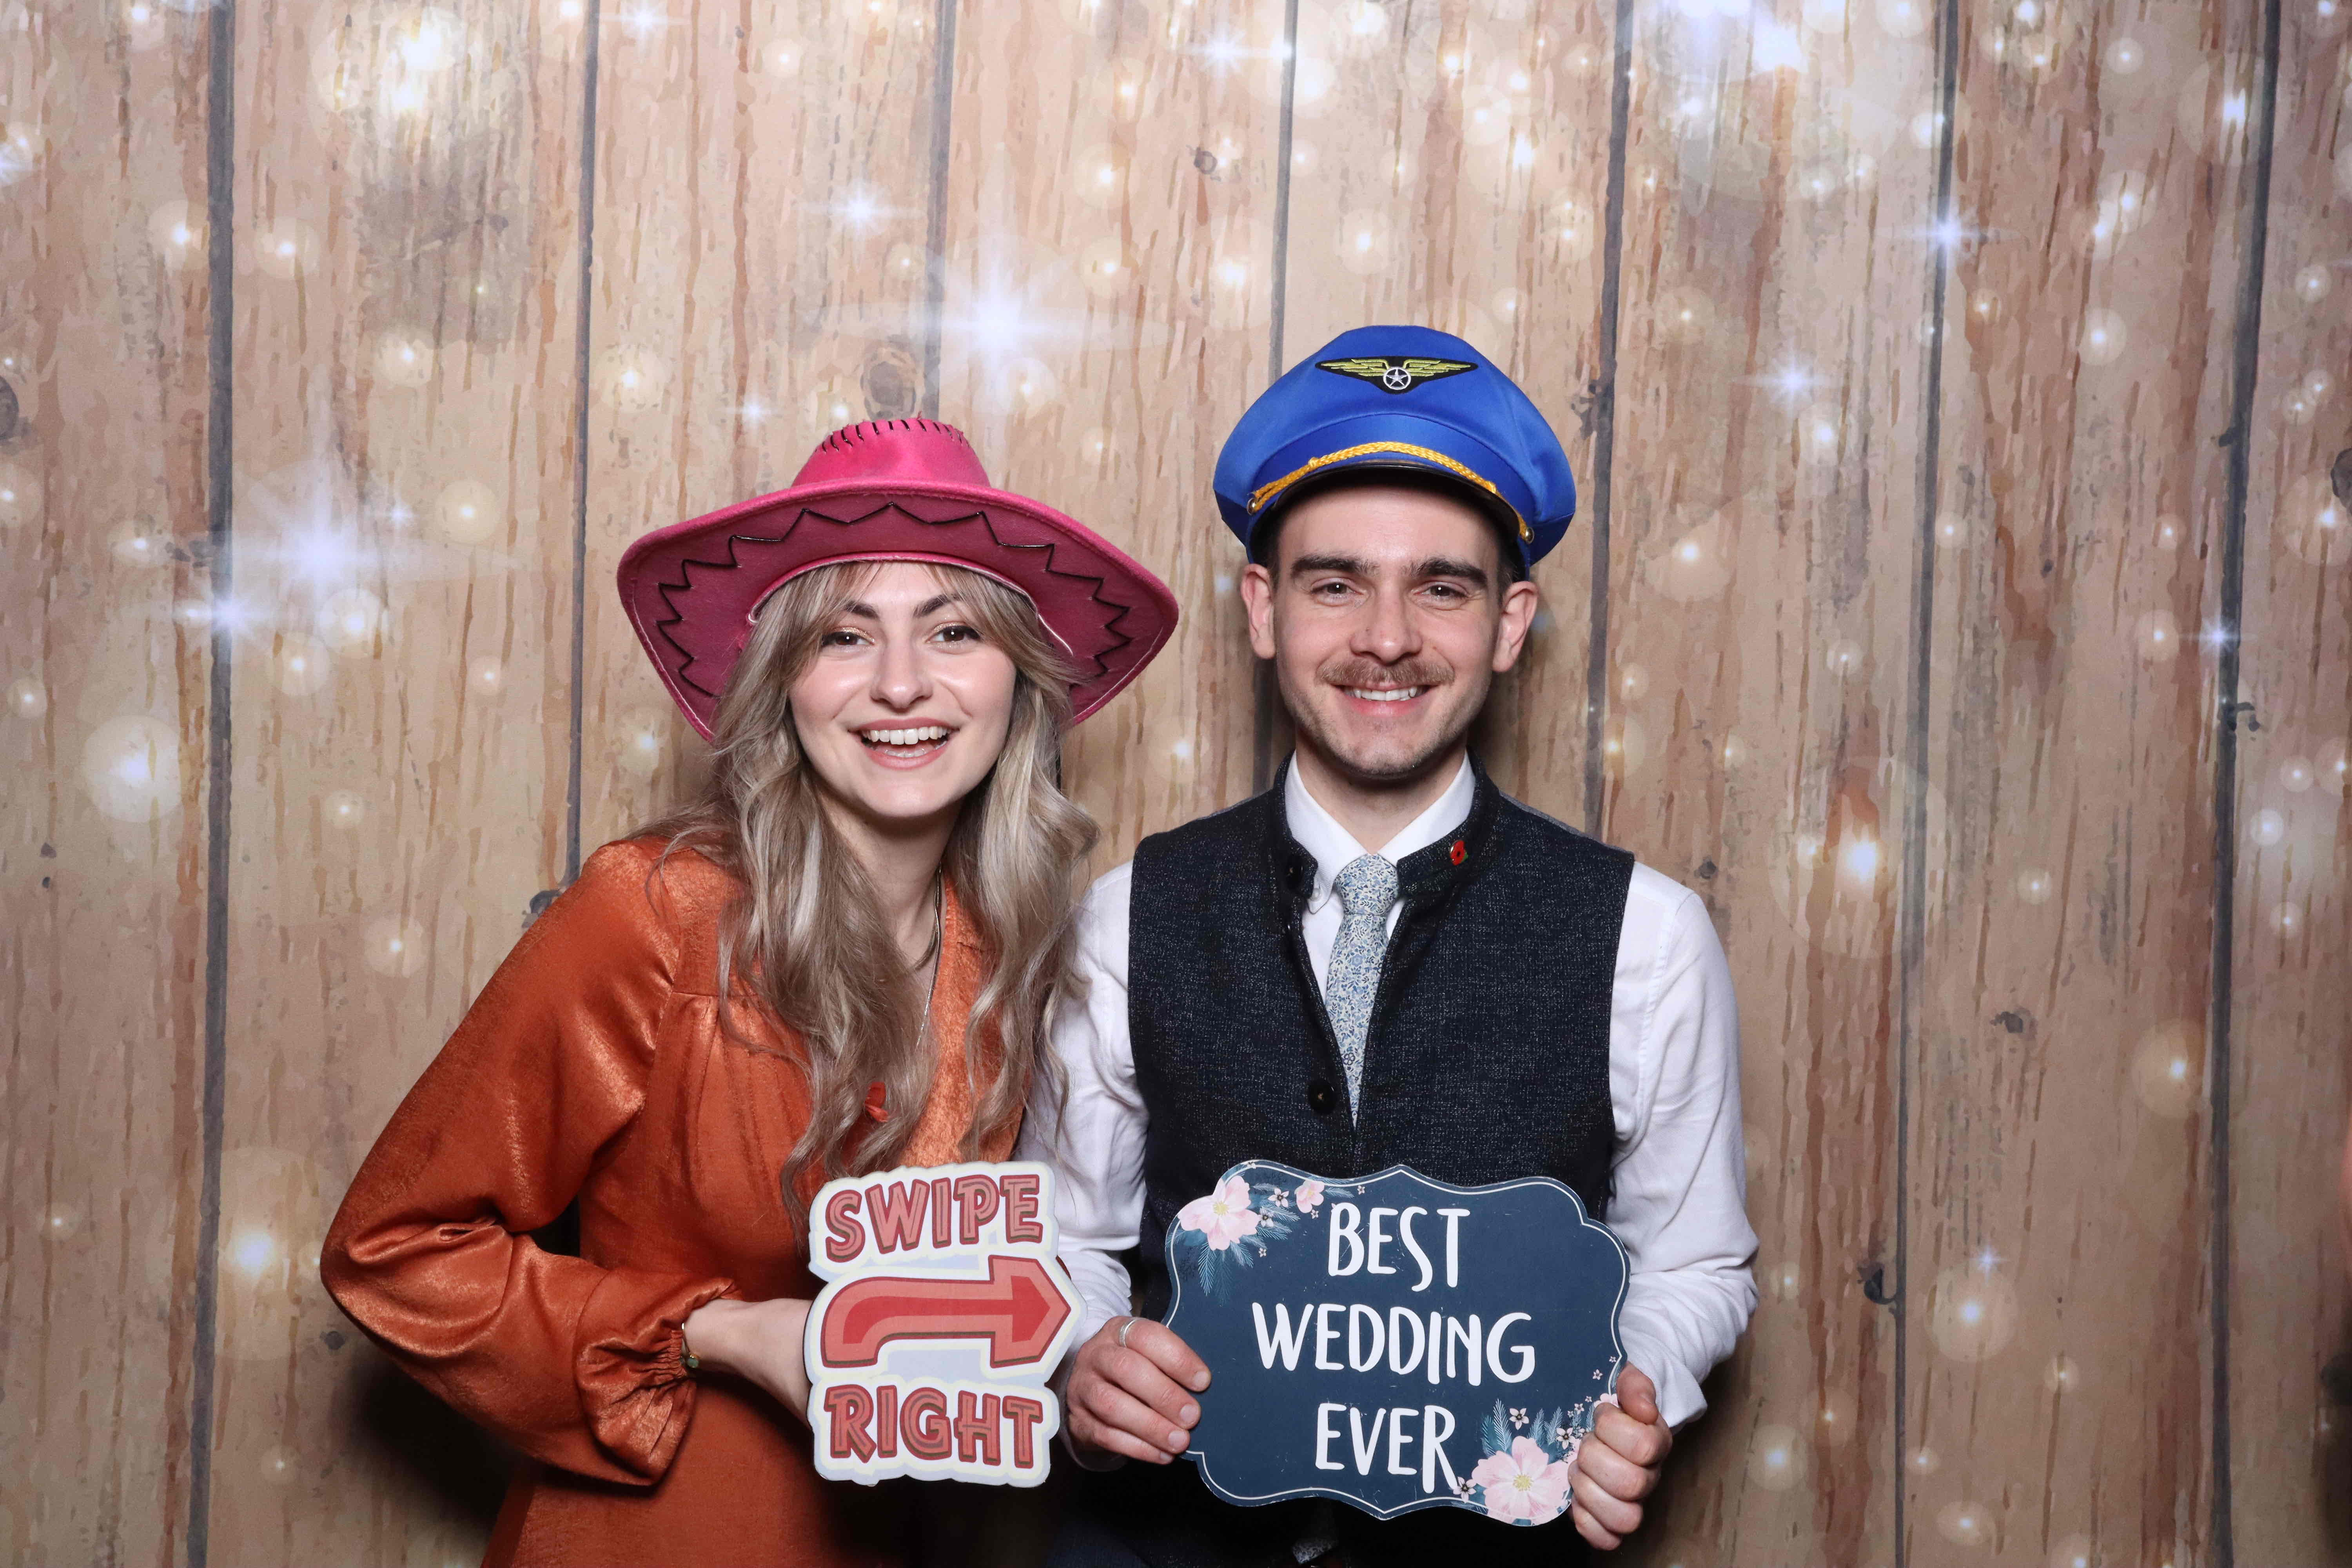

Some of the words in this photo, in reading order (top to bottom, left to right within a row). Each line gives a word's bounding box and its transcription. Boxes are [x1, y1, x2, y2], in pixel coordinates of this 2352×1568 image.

[826, 1174, 1043, 1263] SWIPE
[1328, 1202, 1470, 1292] BEST
[1252, 1302, 1535, 1386] WEDDING
[824, 1384, 1043, 1469] RIGHT
[1316, 1403, 1458, 1494] EVER
